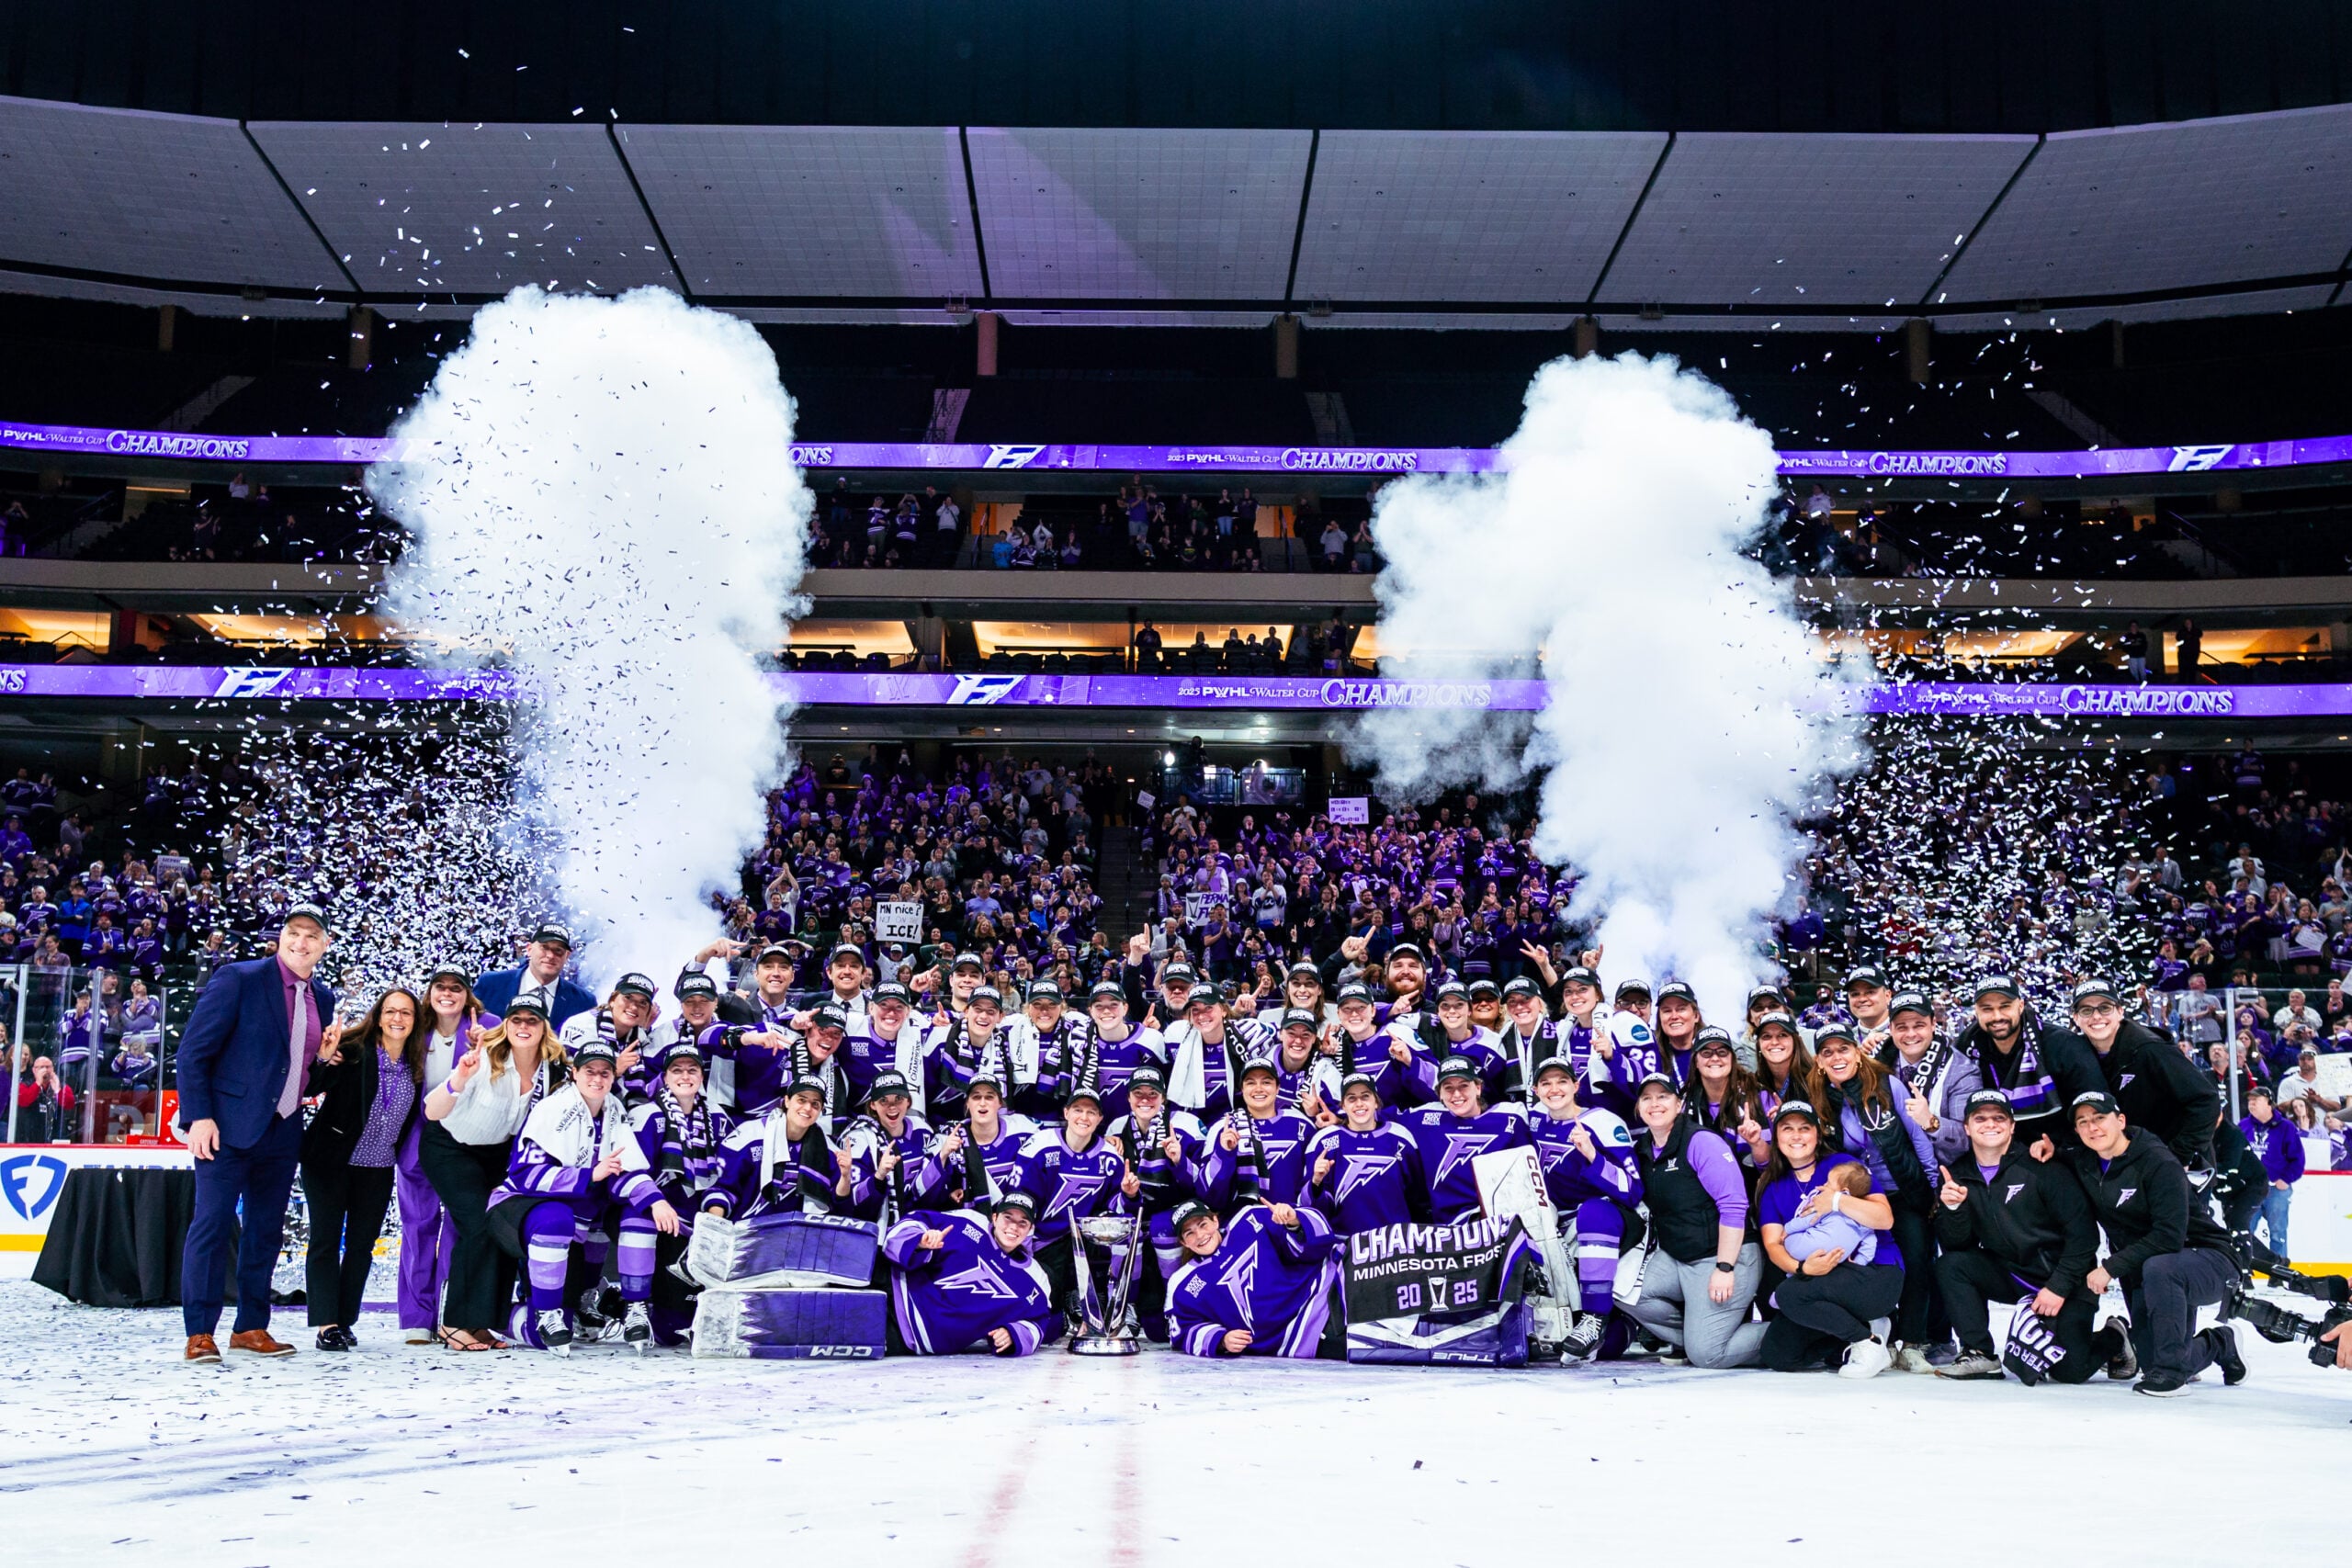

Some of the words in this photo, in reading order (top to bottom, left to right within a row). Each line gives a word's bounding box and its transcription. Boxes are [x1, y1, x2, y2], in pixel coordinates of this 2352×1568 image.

[4, 429, 45, 441] PWHL
[46, 434, 85, 444] WALTER
[85, 435, 105, 445] CUP
[106, 429, 249, 458] CHAMPIONS
[1167, 454, 1185, 462] 2025
[1186, 453, 1225, 463] PWHL
[1225, 453, 1261, 463] WALTER
[1261, 454, 1280, 464] CUP
[1281, 447, 1417, 469] CHAMPIONS
[1869, 451, 2007, 474] CHAMPIONS
[1178, 686, 1200, 696] 2025
[1203, 686, 1250, 698] PWHL
[1250, 687, 1295, 698] WALTER
[1296, 688, 1319, 698] CUP
[1320, 679, 1491, 706] CHAMPIONS
[2060, 685, 2233, 714] CHAMPIONS
[886, 924, 919, 940] ICE!
[1105, 1156, 1117, 1176] C
[1526, 1155, 1549, 1208] CCM
[803, 1213, 866, 1229] CCM
[1353, 1257, 1459, 1282] MINNESOTA
[1396, 1283, 1421, 1310] 20
[1453, 1279, 1478, 1305] 25
[809, 1345, 873, 1357] CCM
[1431, 1351, 1495, 1363] TRUE
